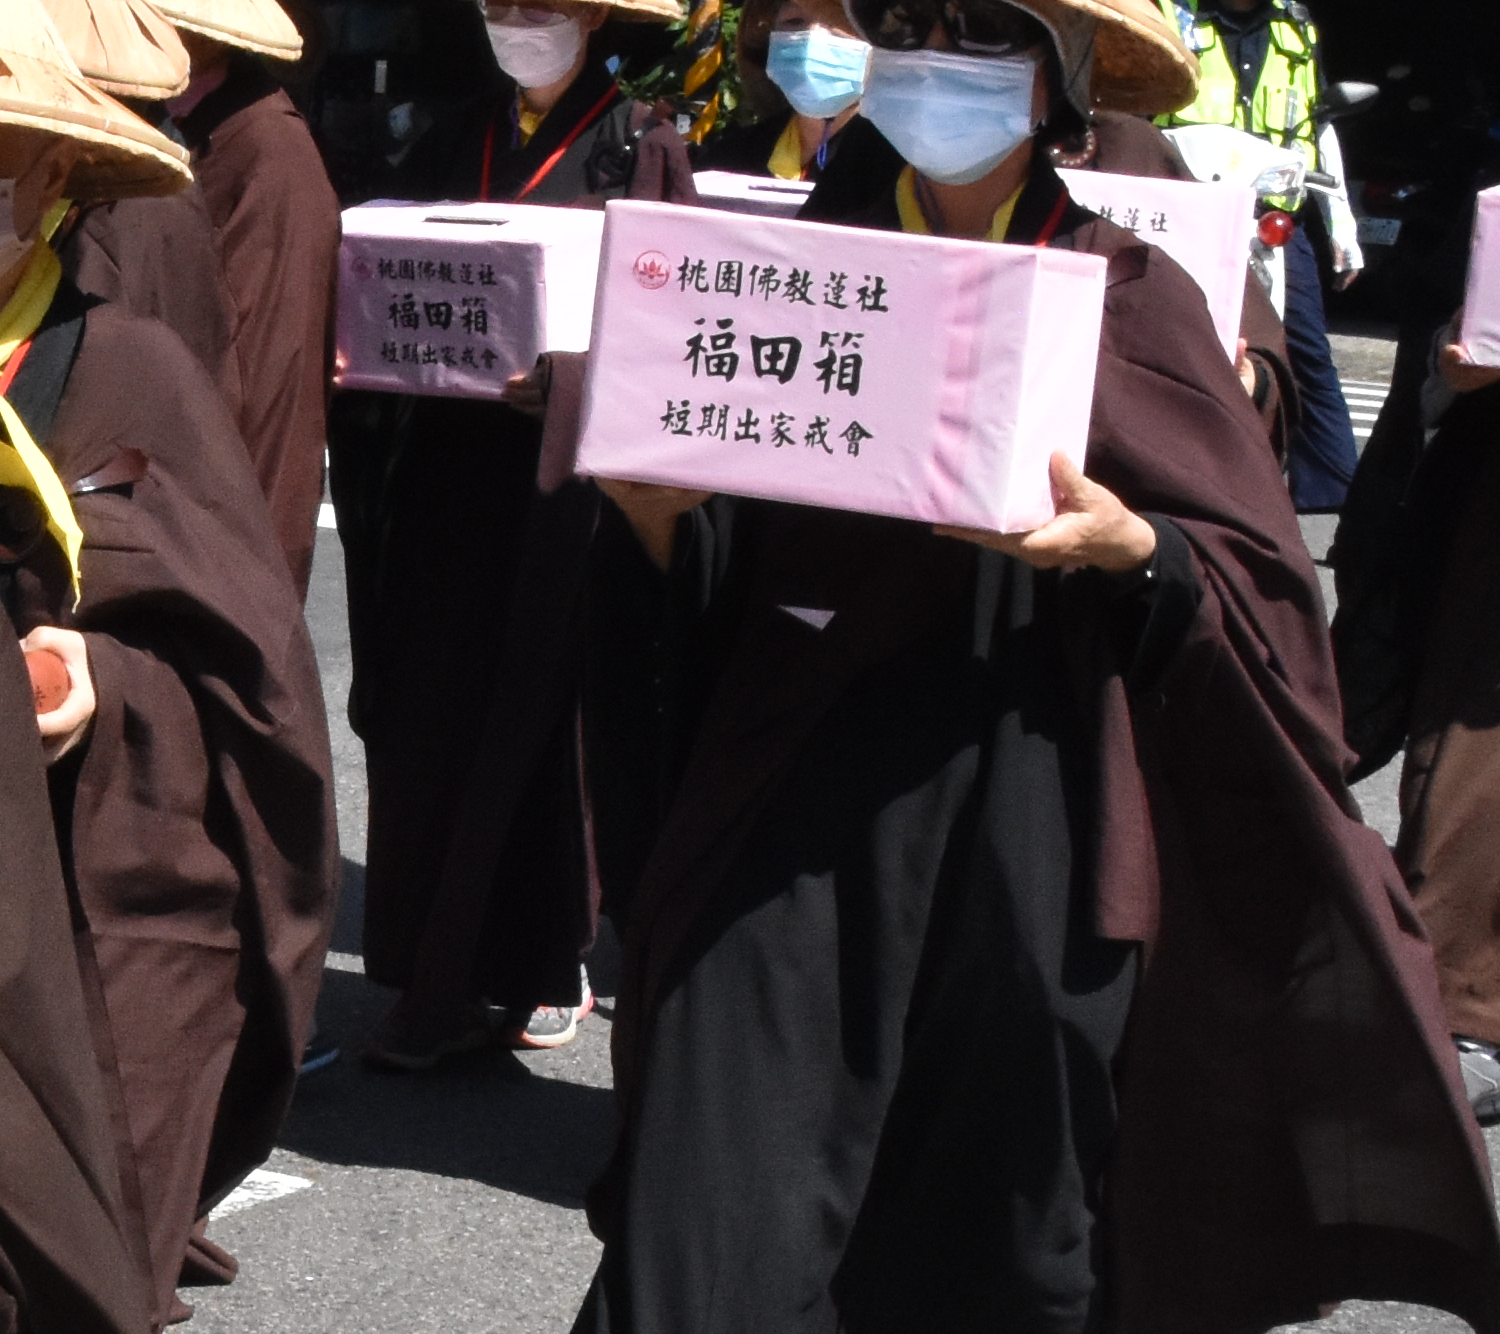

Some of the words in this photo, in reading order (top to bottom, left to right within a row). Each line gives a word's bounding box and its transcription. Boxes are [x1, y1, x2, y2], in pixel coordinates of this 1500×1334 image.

[374, 258, 498, 287] 桃園佛教蓮社
[677, 255, 890, 314] 桃園佛教蓮社
[387, 294, 490, 336] 福田箱
[683, 316, 864, 398] 福田箱
[659, 400, 874, 457] 短期出家戒會
